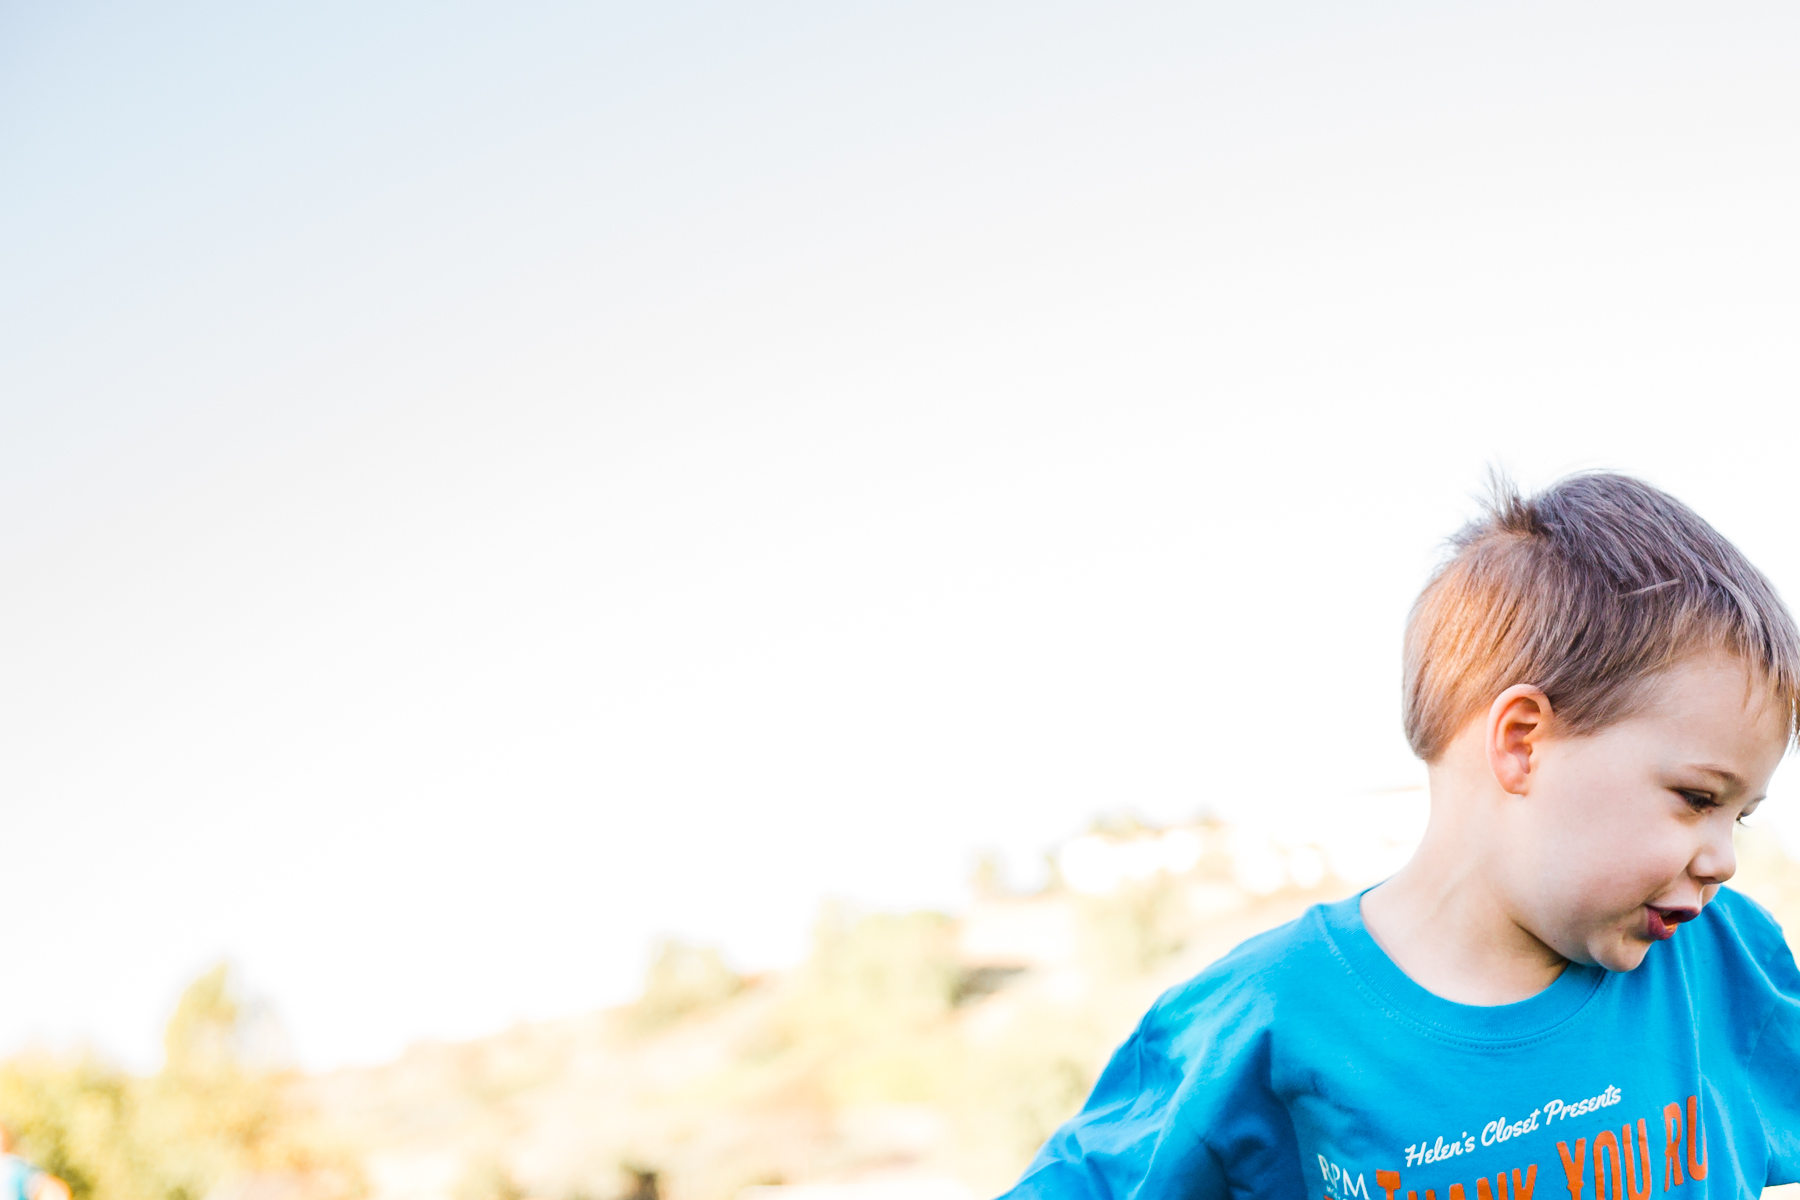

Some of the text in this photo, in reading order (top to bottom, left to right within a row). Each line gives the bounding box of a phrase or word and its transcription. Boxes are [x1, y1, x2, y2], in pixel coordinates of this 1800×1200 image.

[1404, 1084, 1622, 1167] Helen's Closet Presents
[1317, 1152, 1371, 1200] RPM
